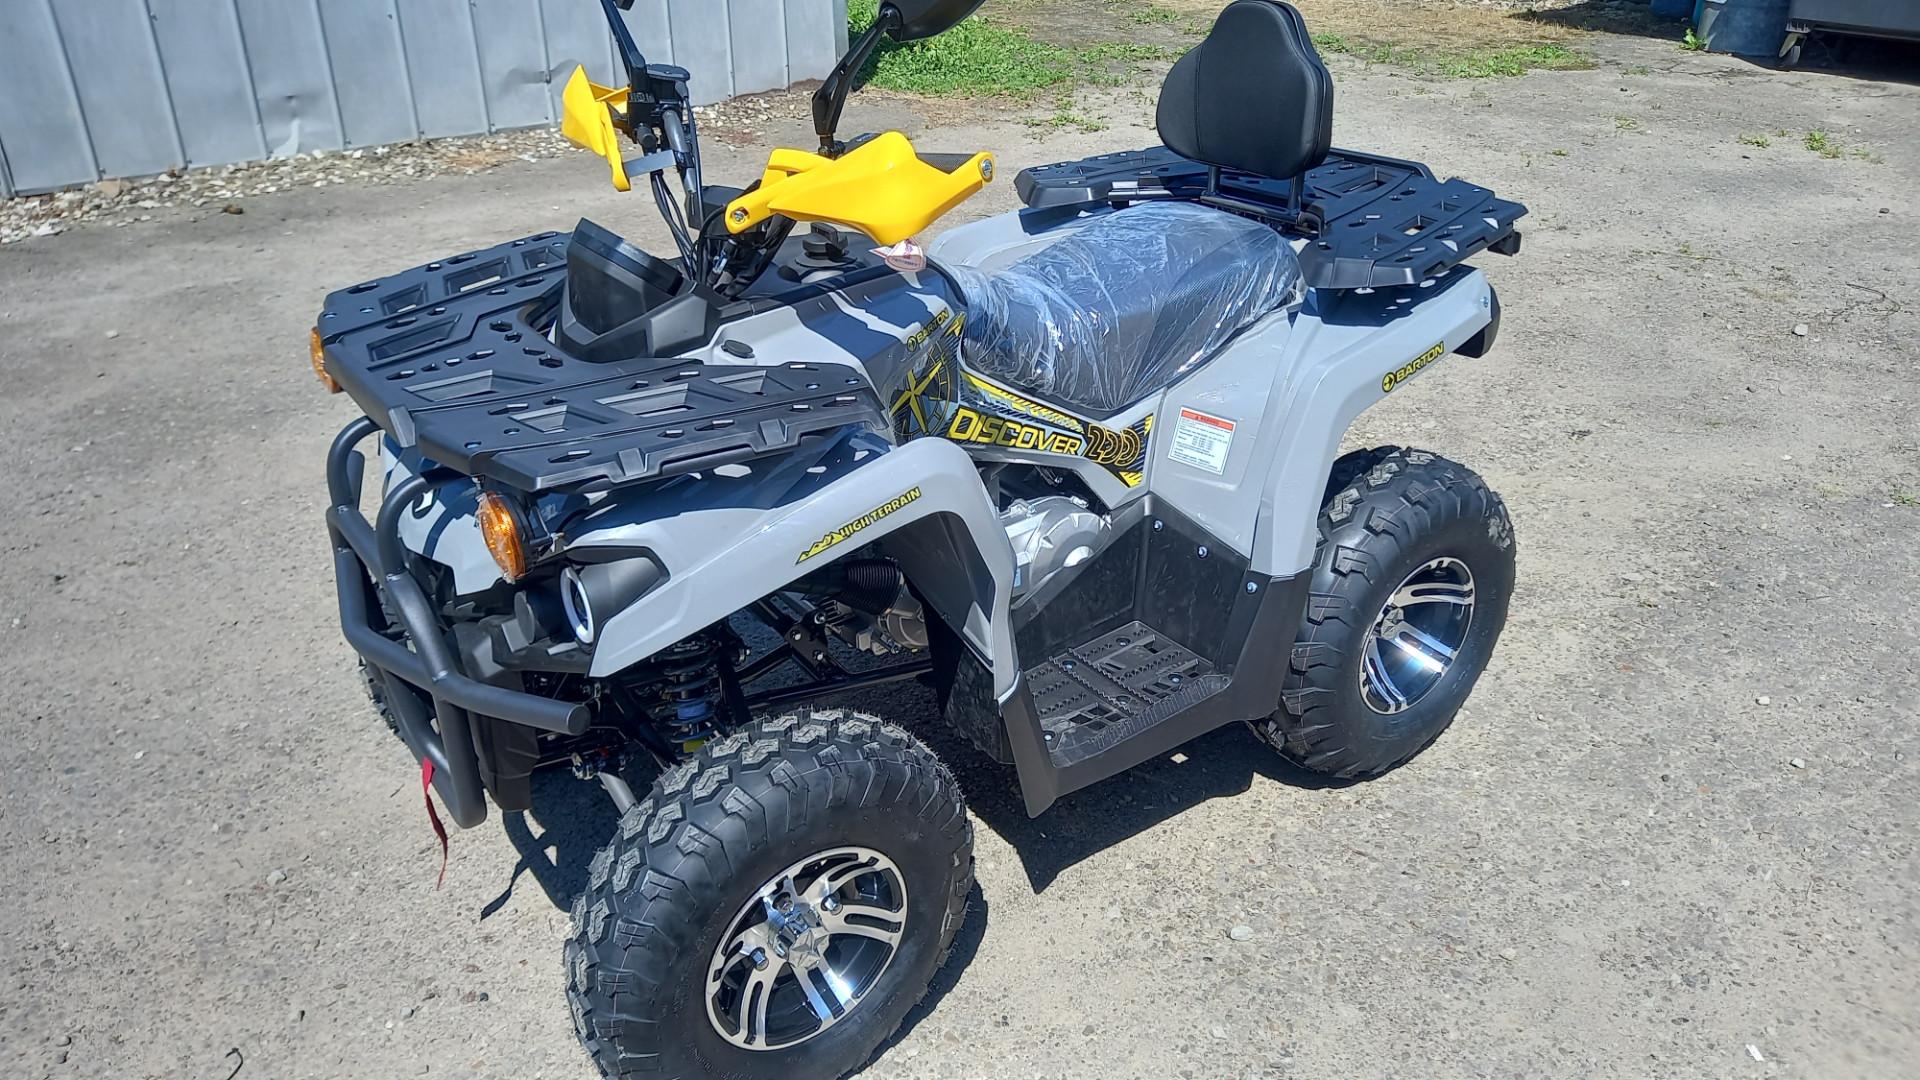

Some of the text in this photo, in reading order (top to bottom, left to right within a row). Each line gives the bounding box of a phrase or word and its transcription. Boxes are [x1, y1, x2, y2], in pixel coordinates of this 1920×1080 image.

[916, 308, 949, 344] BARTON
[1396, 341, 1444, 383] BARTON
[946, 407, 1082, 456] DISCOVER
[1083, 423, 1140, 467] 200
[840, 486, 921, 539] HIGH TERRAIN
